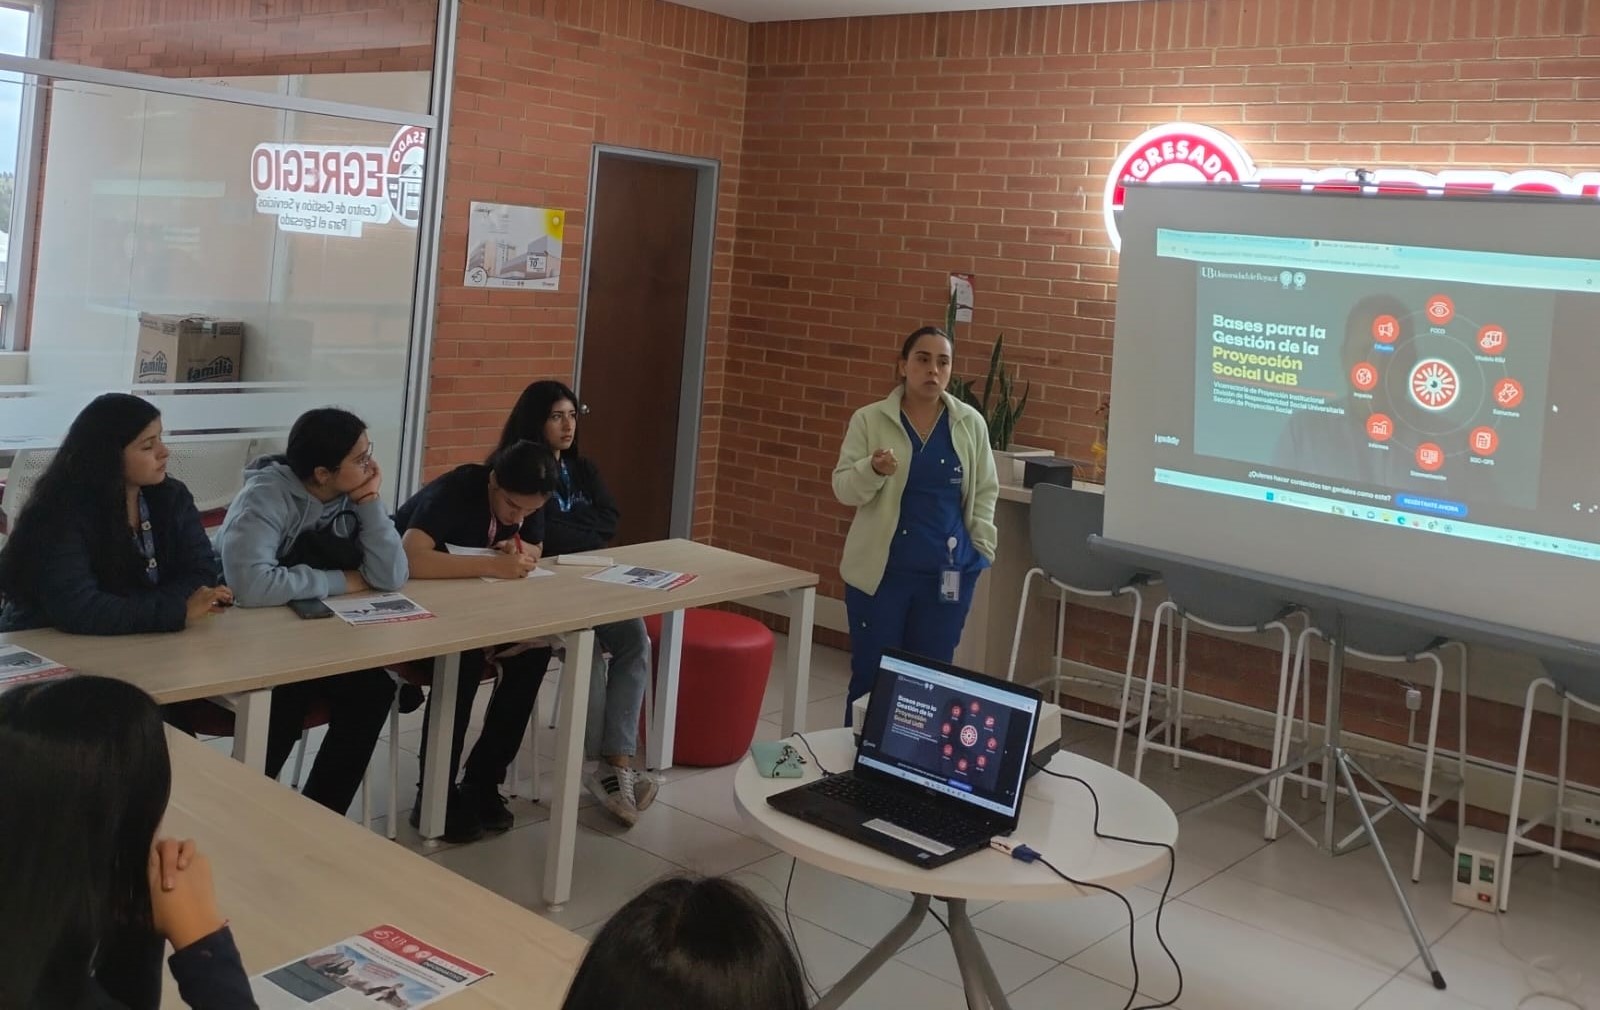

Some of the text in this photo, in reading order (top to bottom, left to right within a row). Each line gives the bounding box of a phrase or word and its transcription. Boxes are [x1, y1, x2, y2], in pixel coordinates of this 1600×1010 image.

[1213, 314, 1326, 339] Bases para la
[1213, 330, 1319, 355] Gestión de la
[1212, 346, 1303, 371] Proyección
[1212, 361, 1298, 386] Social UdB
